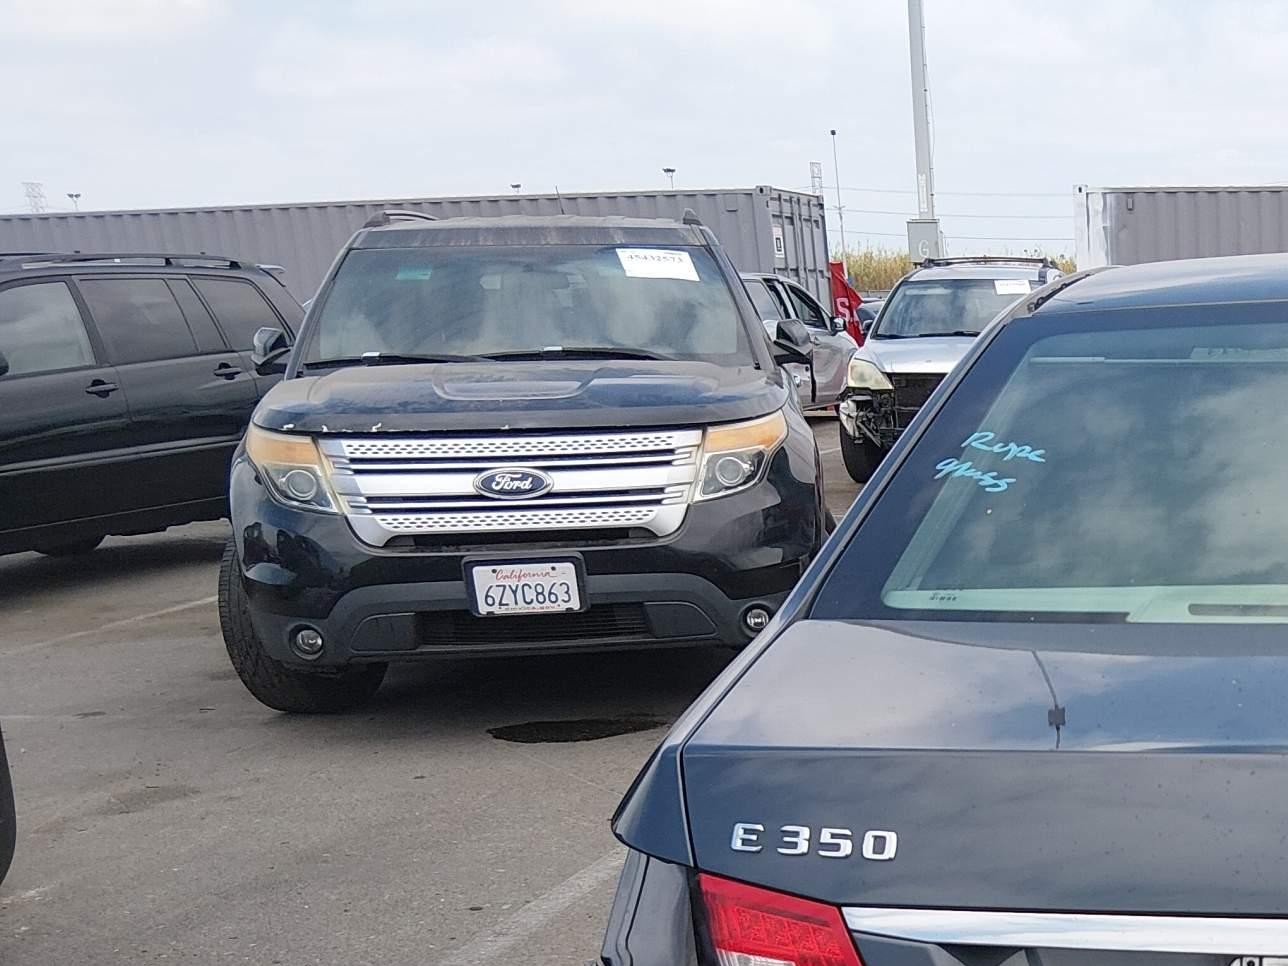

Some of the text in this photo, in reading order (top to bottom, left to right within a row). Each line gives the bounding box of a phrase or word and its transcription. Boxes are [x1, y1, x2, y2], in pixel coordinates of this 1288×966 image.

[492, 473, 533, 490] Ford
[495, 569, 555, 582] California
[484, 582, 571, 607] 6ZYC863
[730, 822, 898, 861] E 350
